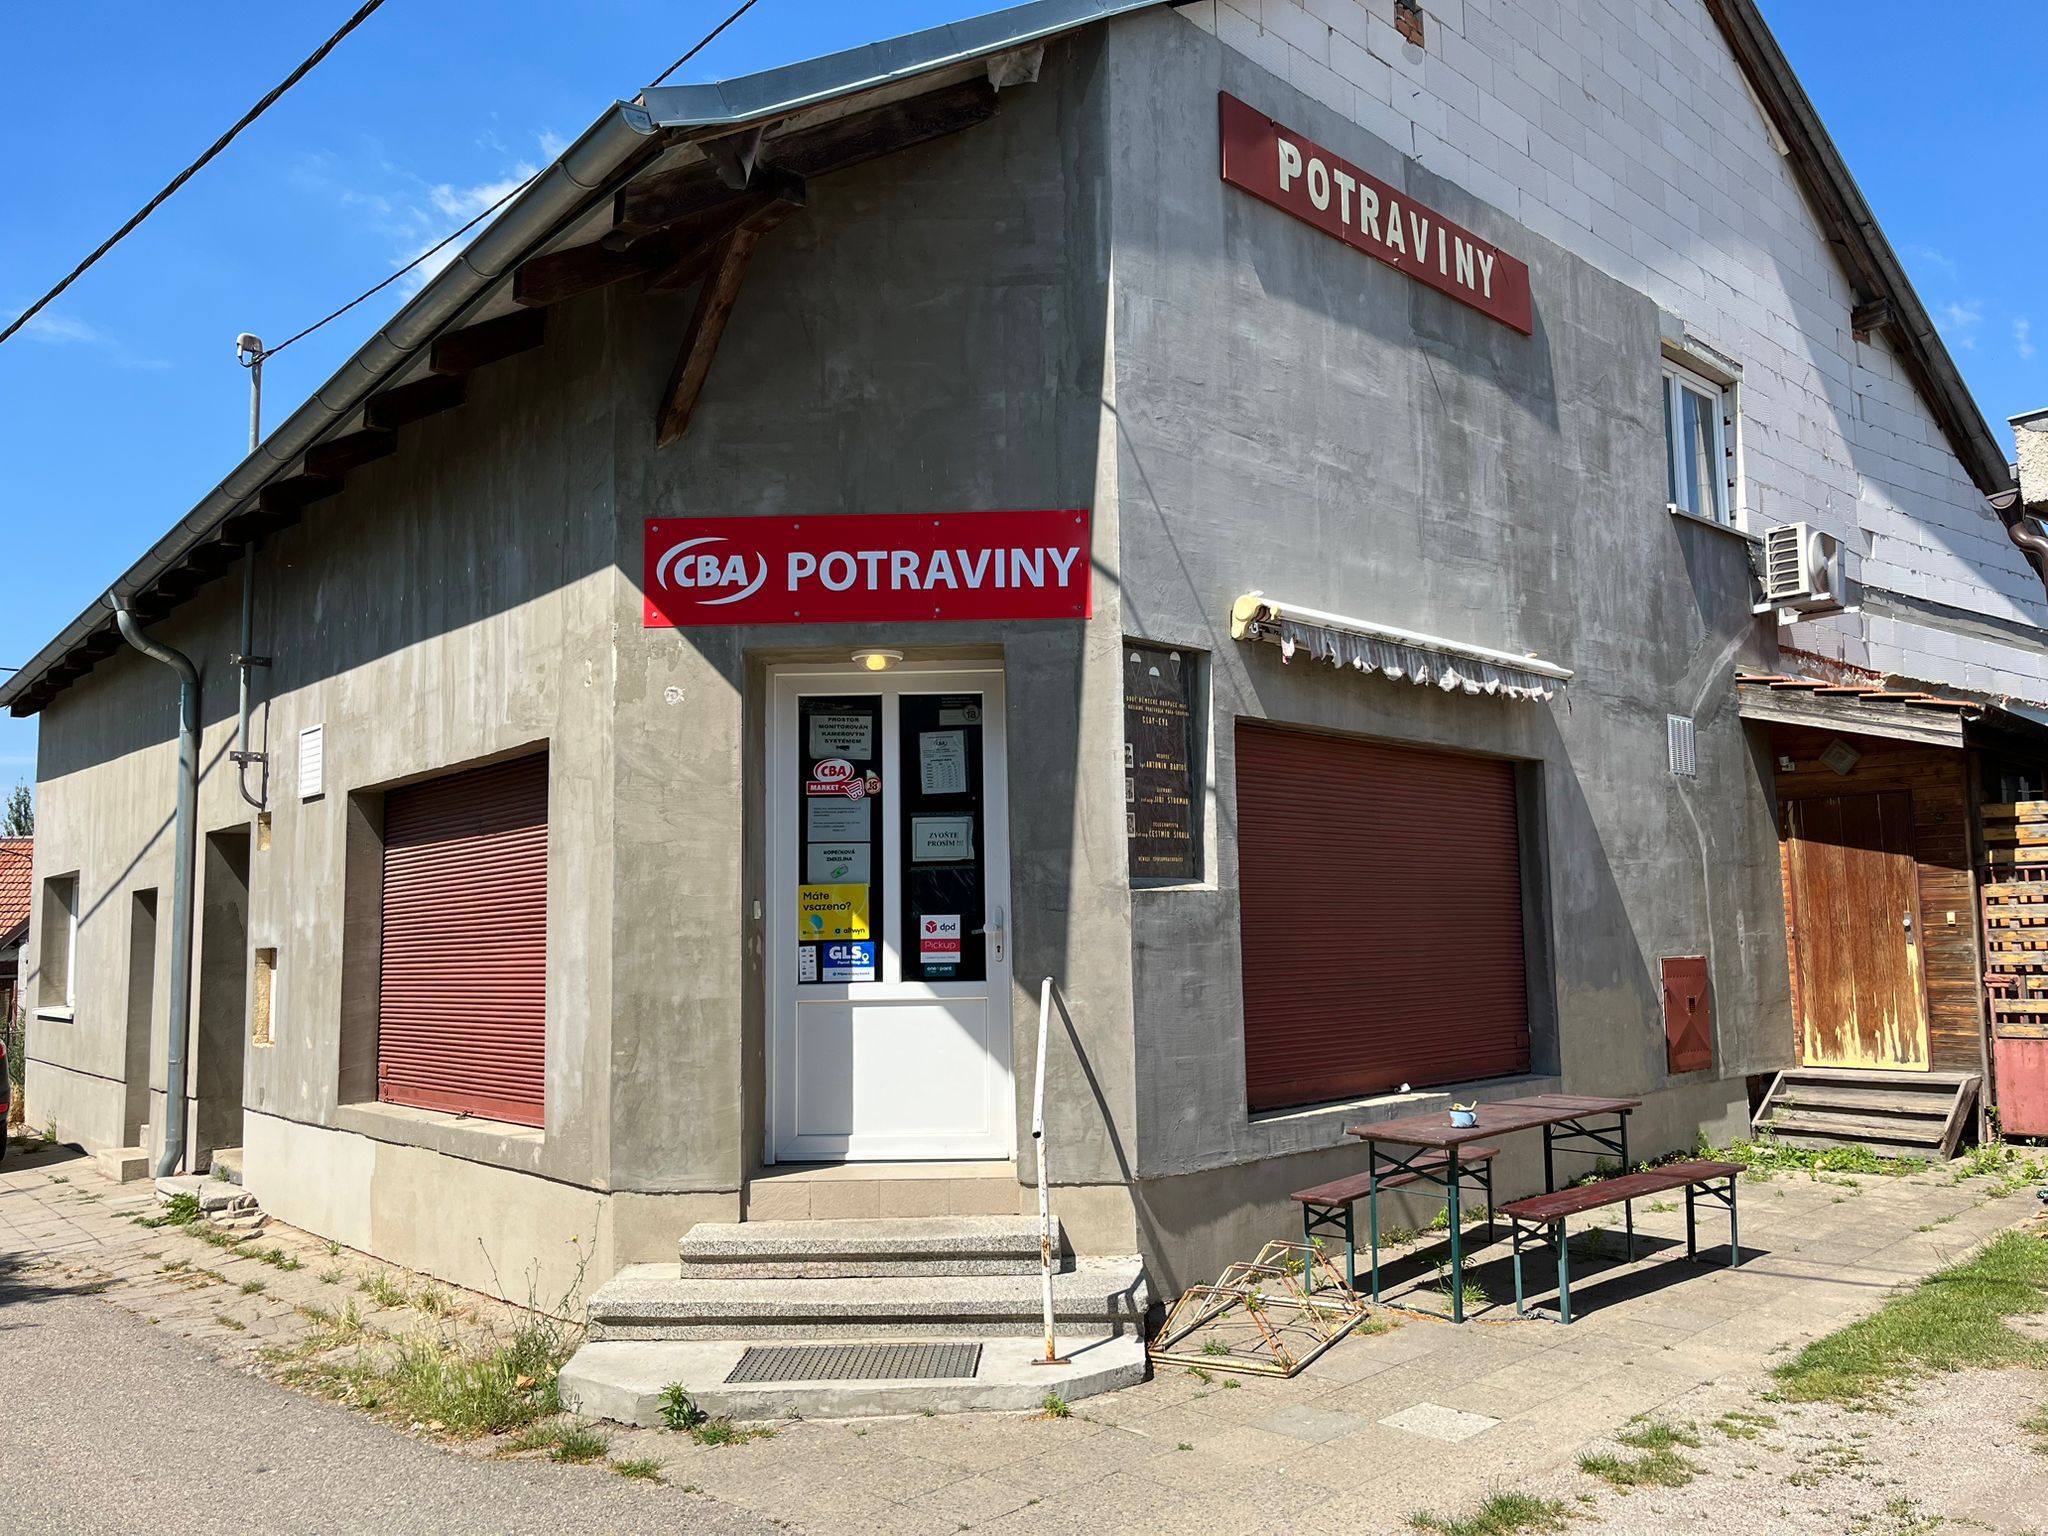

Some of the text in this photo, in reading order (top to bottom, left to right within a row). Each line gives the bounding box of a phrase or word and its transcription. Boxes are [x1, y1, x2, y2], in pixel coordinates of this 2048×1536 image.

[1278, 137, 1494, 298] POTRAVINY
[673, 547, 1081, 592] CBA POTRAVINY
[966, 711, 976, 719] 18
[821, 765, 847, 777] CBA
[803, 891, 830, 901] Máte
[803, 901, 852, 911] vsazeno?
[843, 927, 866, 935] allwyn
[940, 923, 956, 932] dpd
[924, 940, 957, 950] Pickup
[829, 945, 862, 960] GLS
